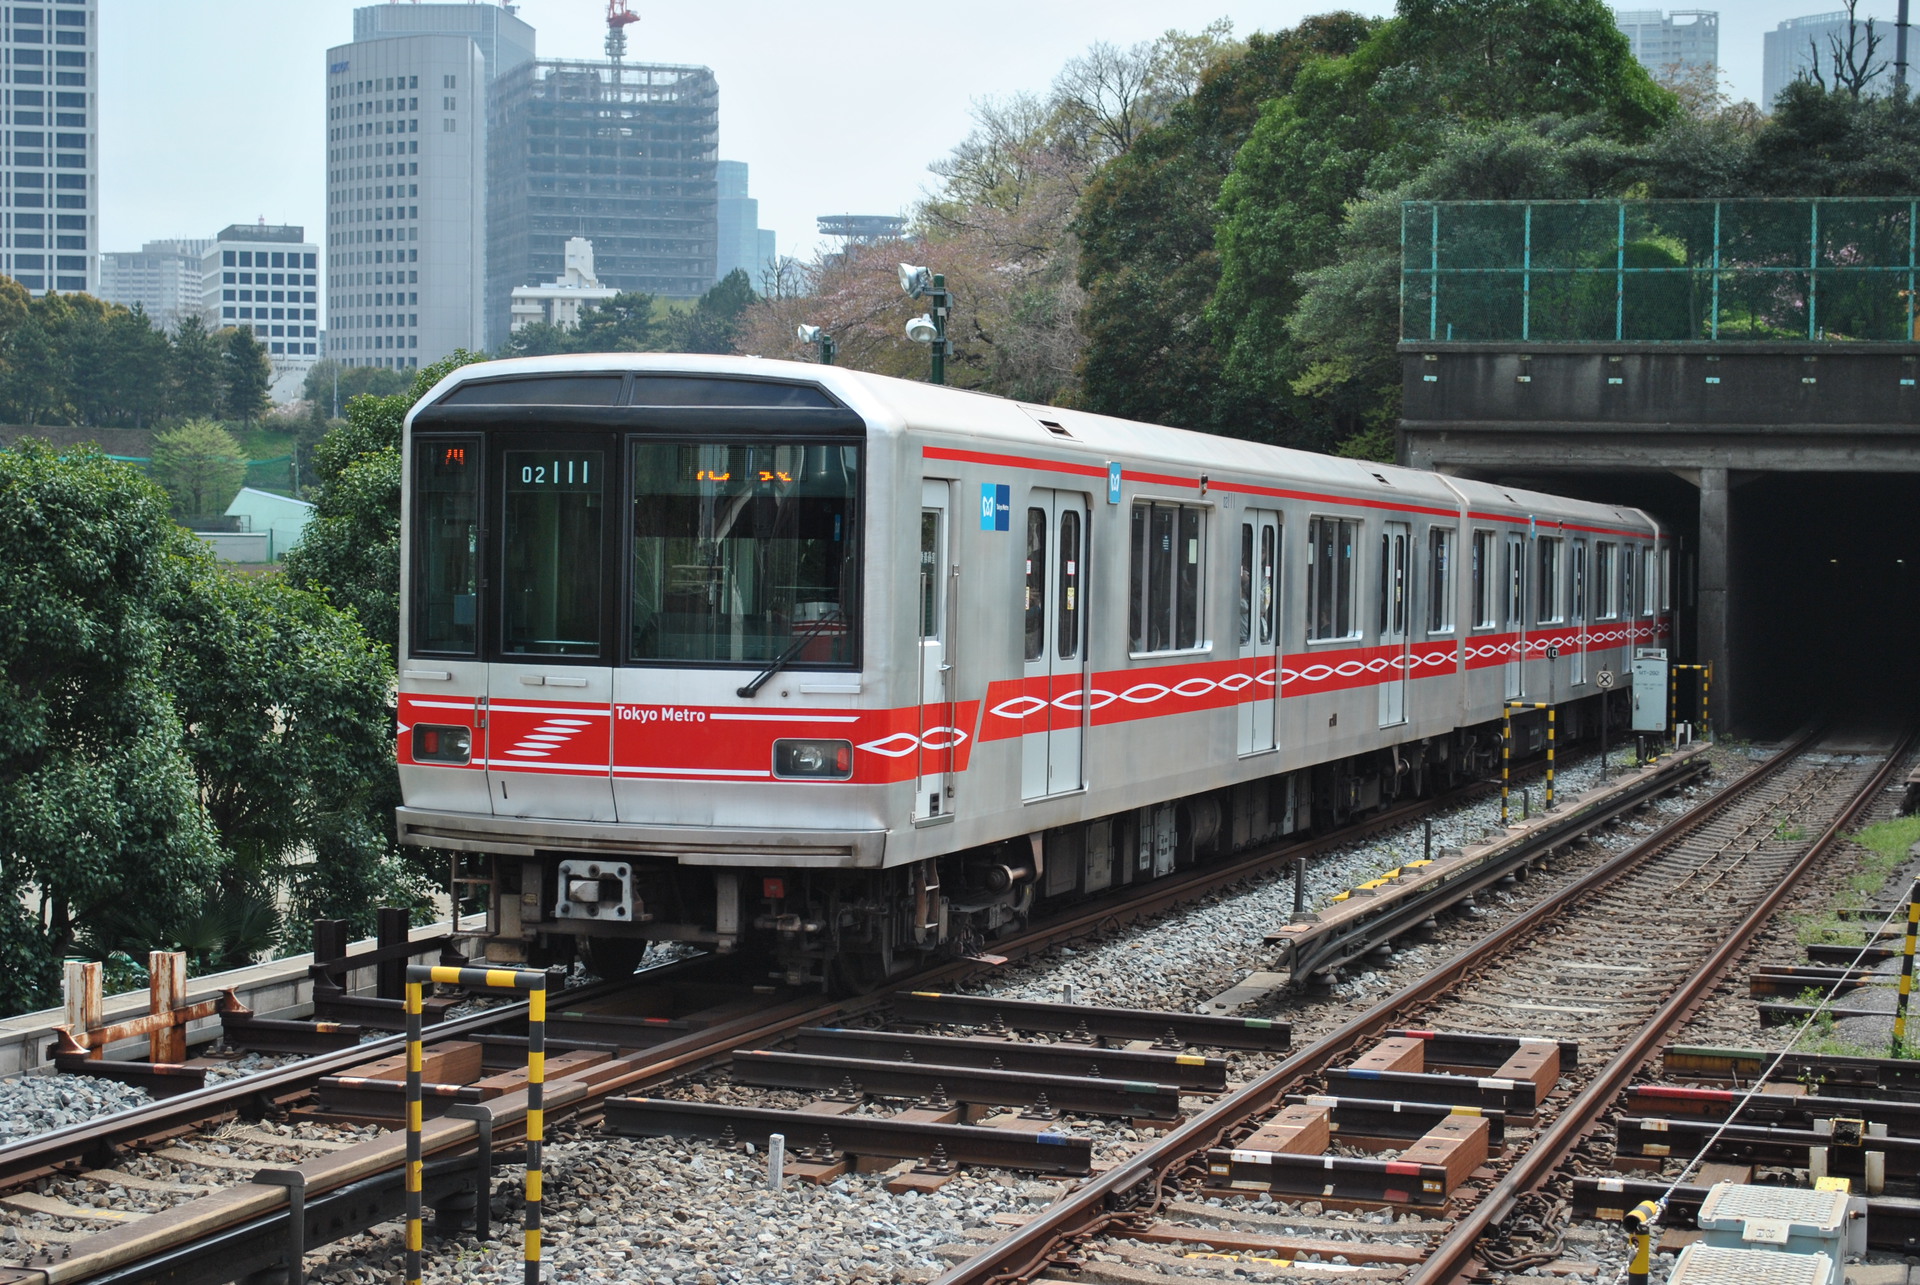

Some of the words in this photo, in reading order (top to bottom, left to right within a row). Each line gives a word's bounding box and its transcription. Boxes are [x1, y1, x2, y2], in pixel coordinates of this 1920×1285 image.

[1547, 649, 1558, 658] 10
[615, 706, 658, 724] Tokyo
[661, 707, 706, 722] Metro
